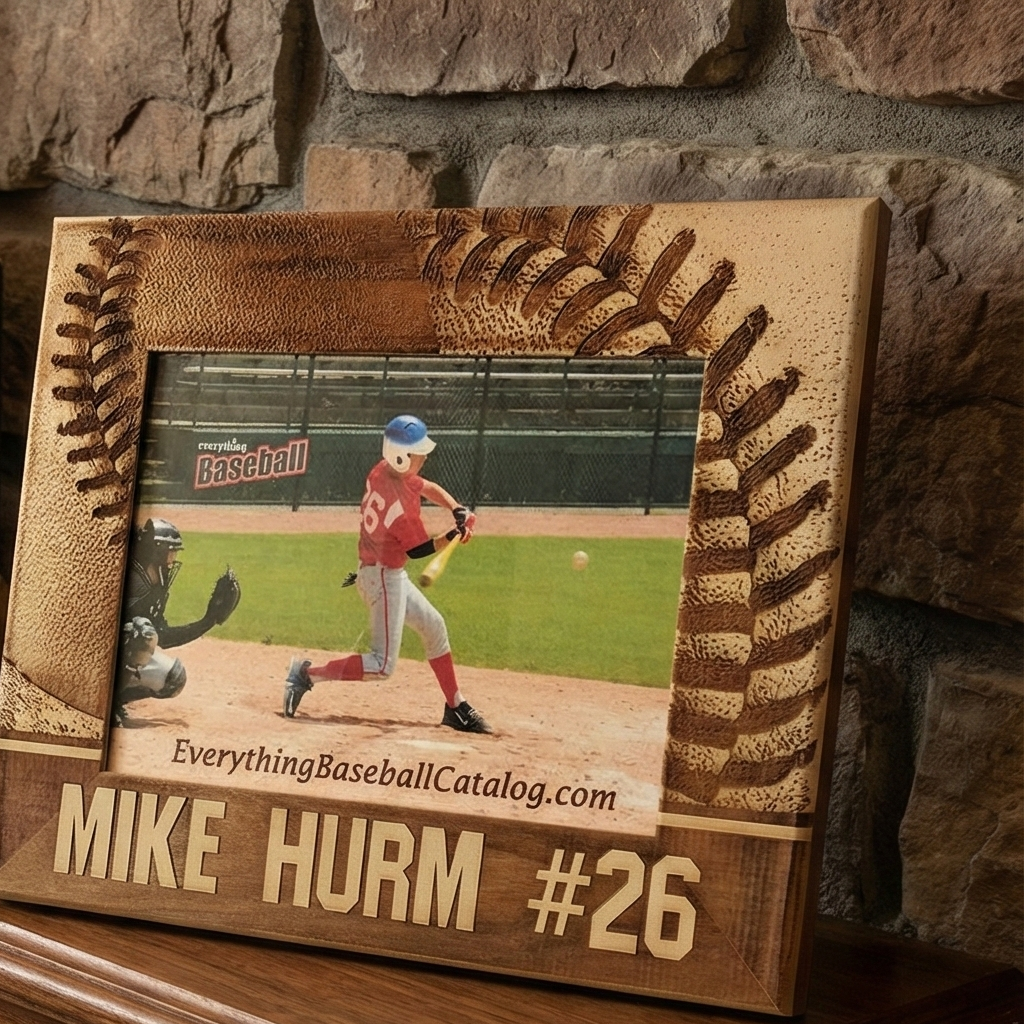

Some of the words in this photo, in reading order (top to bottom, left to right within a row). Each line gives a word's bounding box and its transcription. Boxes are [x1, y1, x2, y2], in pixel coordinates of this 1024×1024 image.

[194, 438, 309, 490] Baseball
[171, 738, 617, 811] EverythingBaseballCatalog.com
[53, 783, 226, 894] MIKE
[262, 807, 485, 932] HURM
[527, 849, 701, 961] #26
